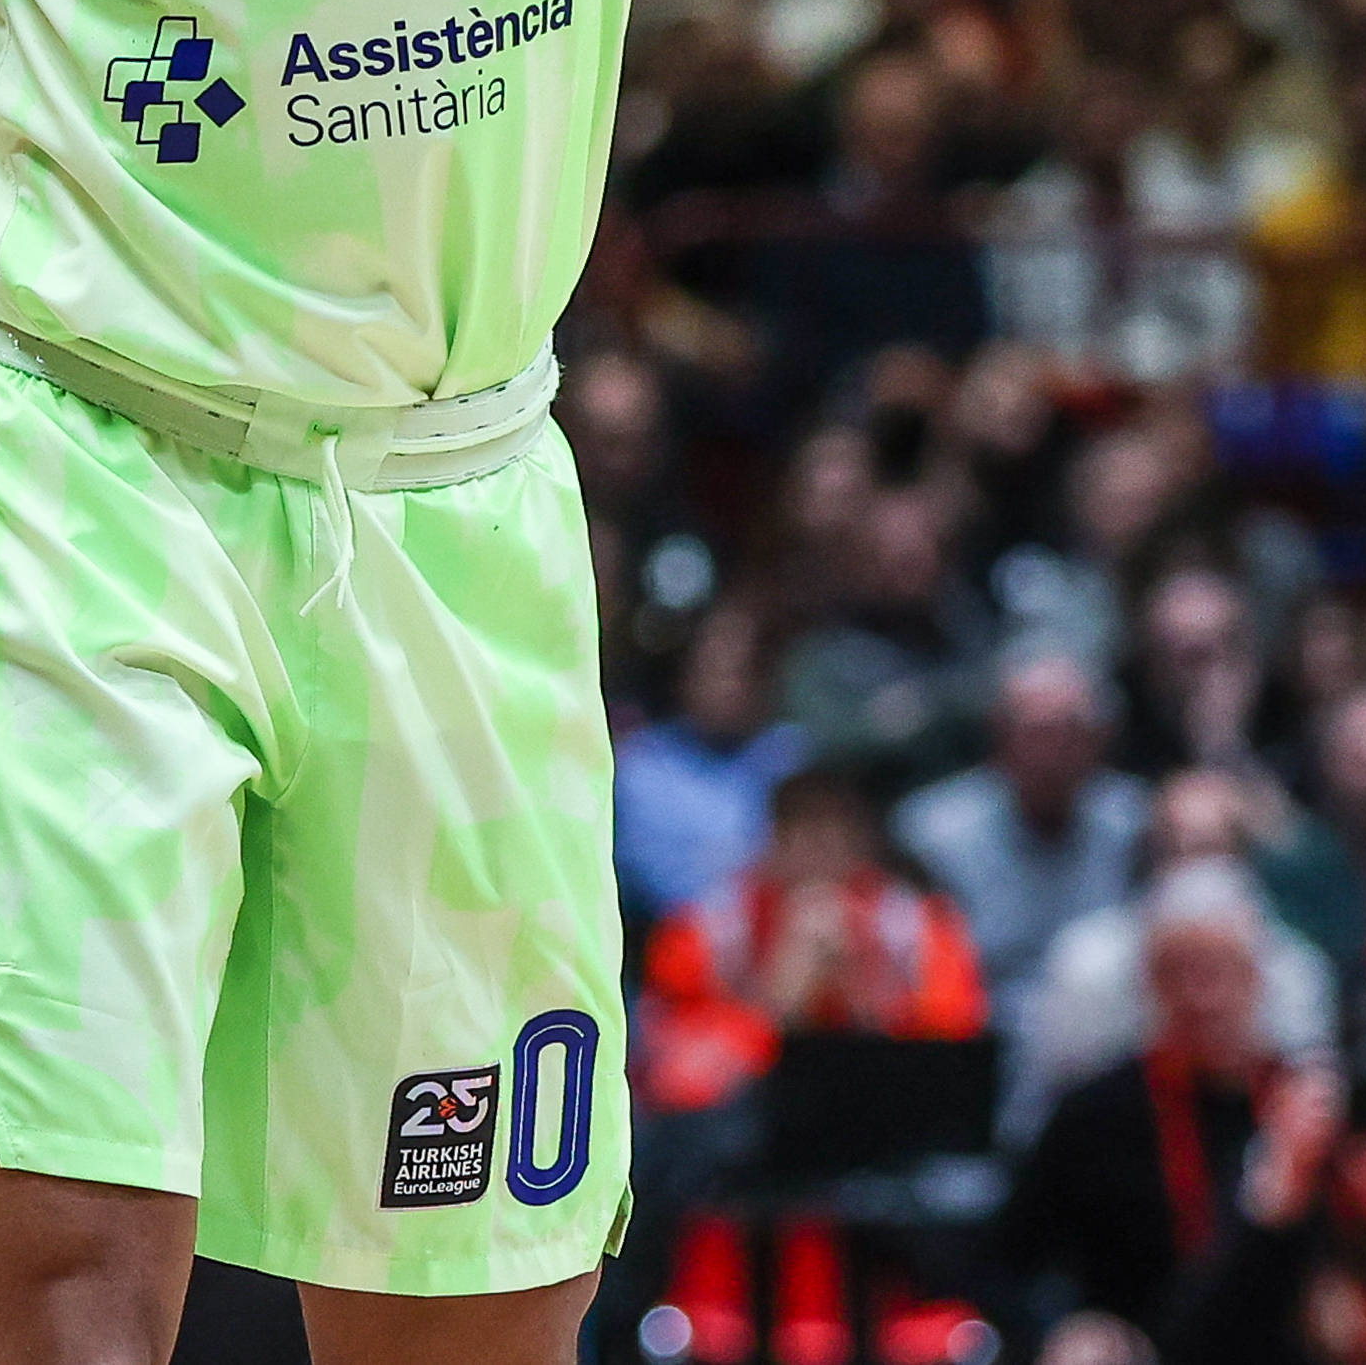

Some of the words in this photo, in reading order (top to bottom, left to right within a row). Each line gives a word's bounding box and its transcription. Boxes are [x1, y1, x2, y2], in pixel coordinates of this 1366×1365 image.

[287, 69, 506, 147] Sanitària
[505, 1009, 600, 1206] 0
[399, 1142, 483, 1164] TURKISH
[395, 1159, 482, 1181] AIRLINES
[394, 1178, 480, 1195] EuroLeague
